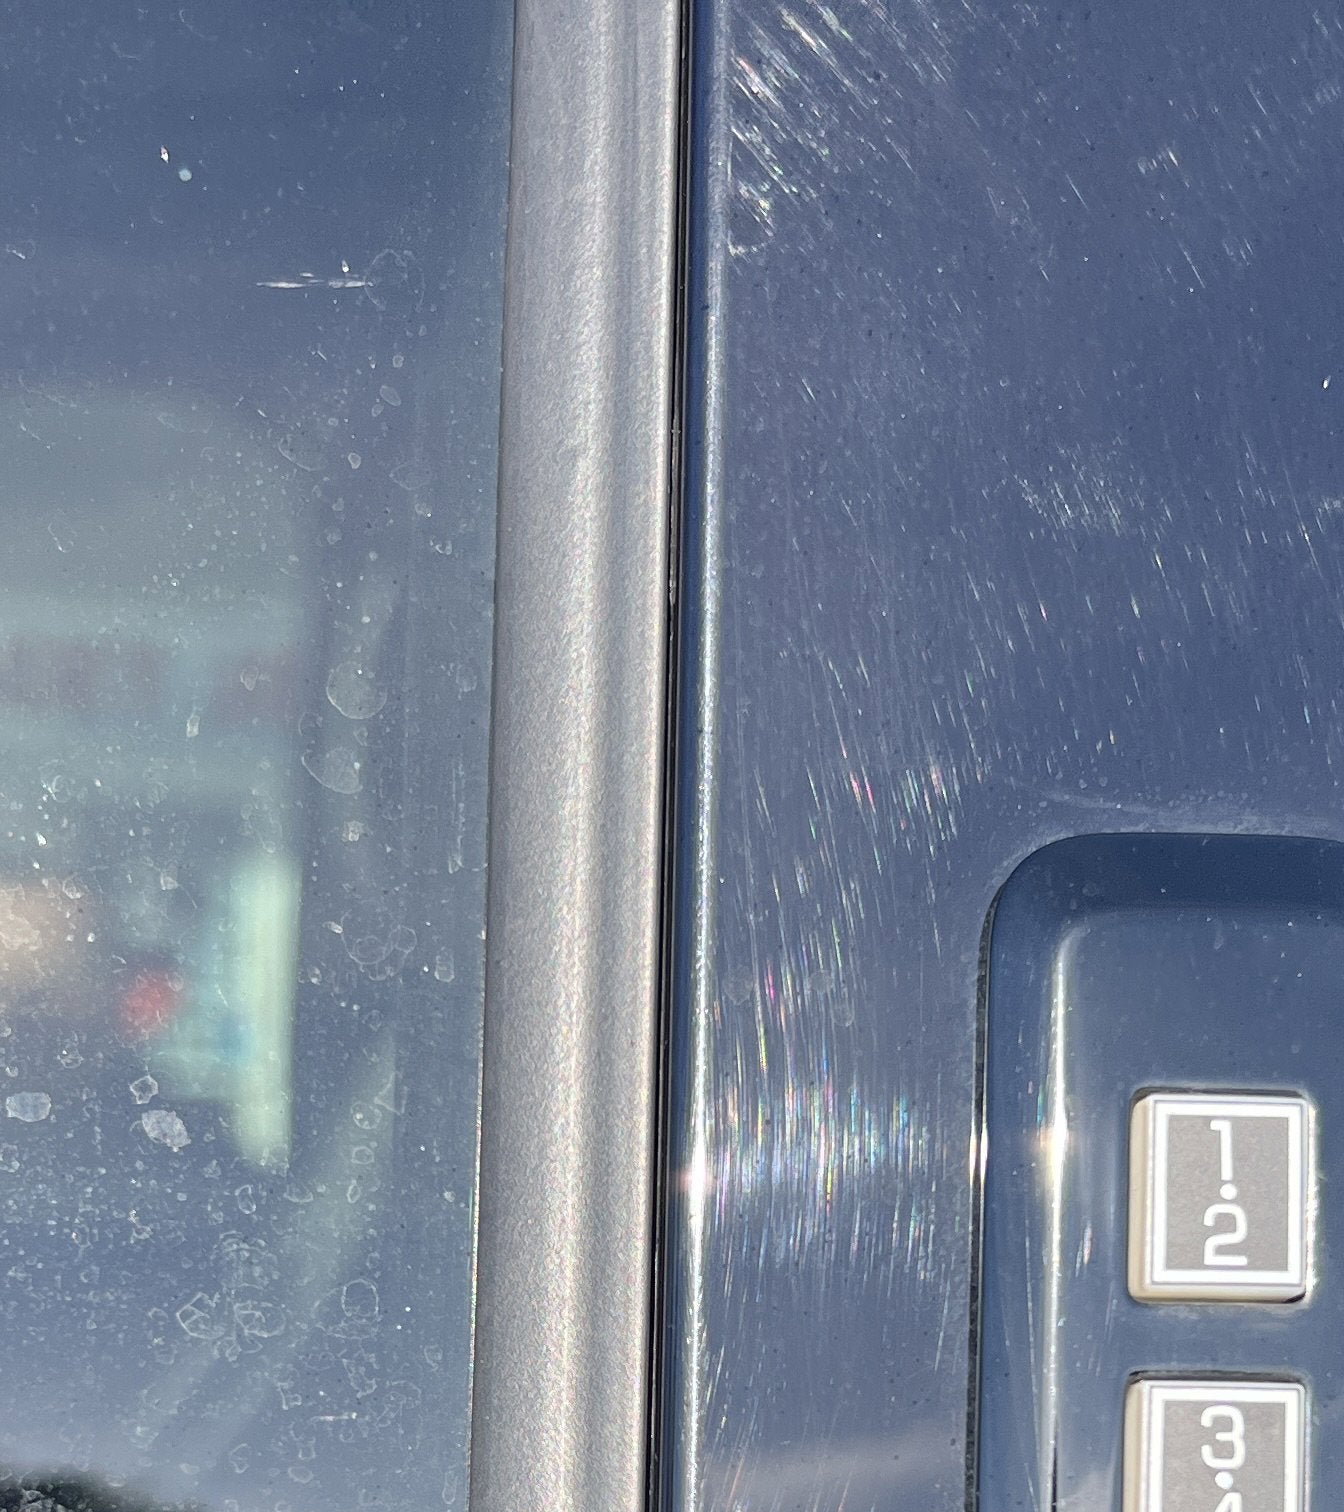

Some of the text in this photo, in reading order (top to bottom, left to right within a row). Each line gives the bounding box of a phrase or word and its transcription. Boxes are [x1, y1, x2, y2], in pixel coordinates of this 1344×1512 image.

[1210, 1119, 1233, 1181] 1
[1203, 1204, 1248, 1266] 2
[1200, 1404, 1245, 1470] 3
